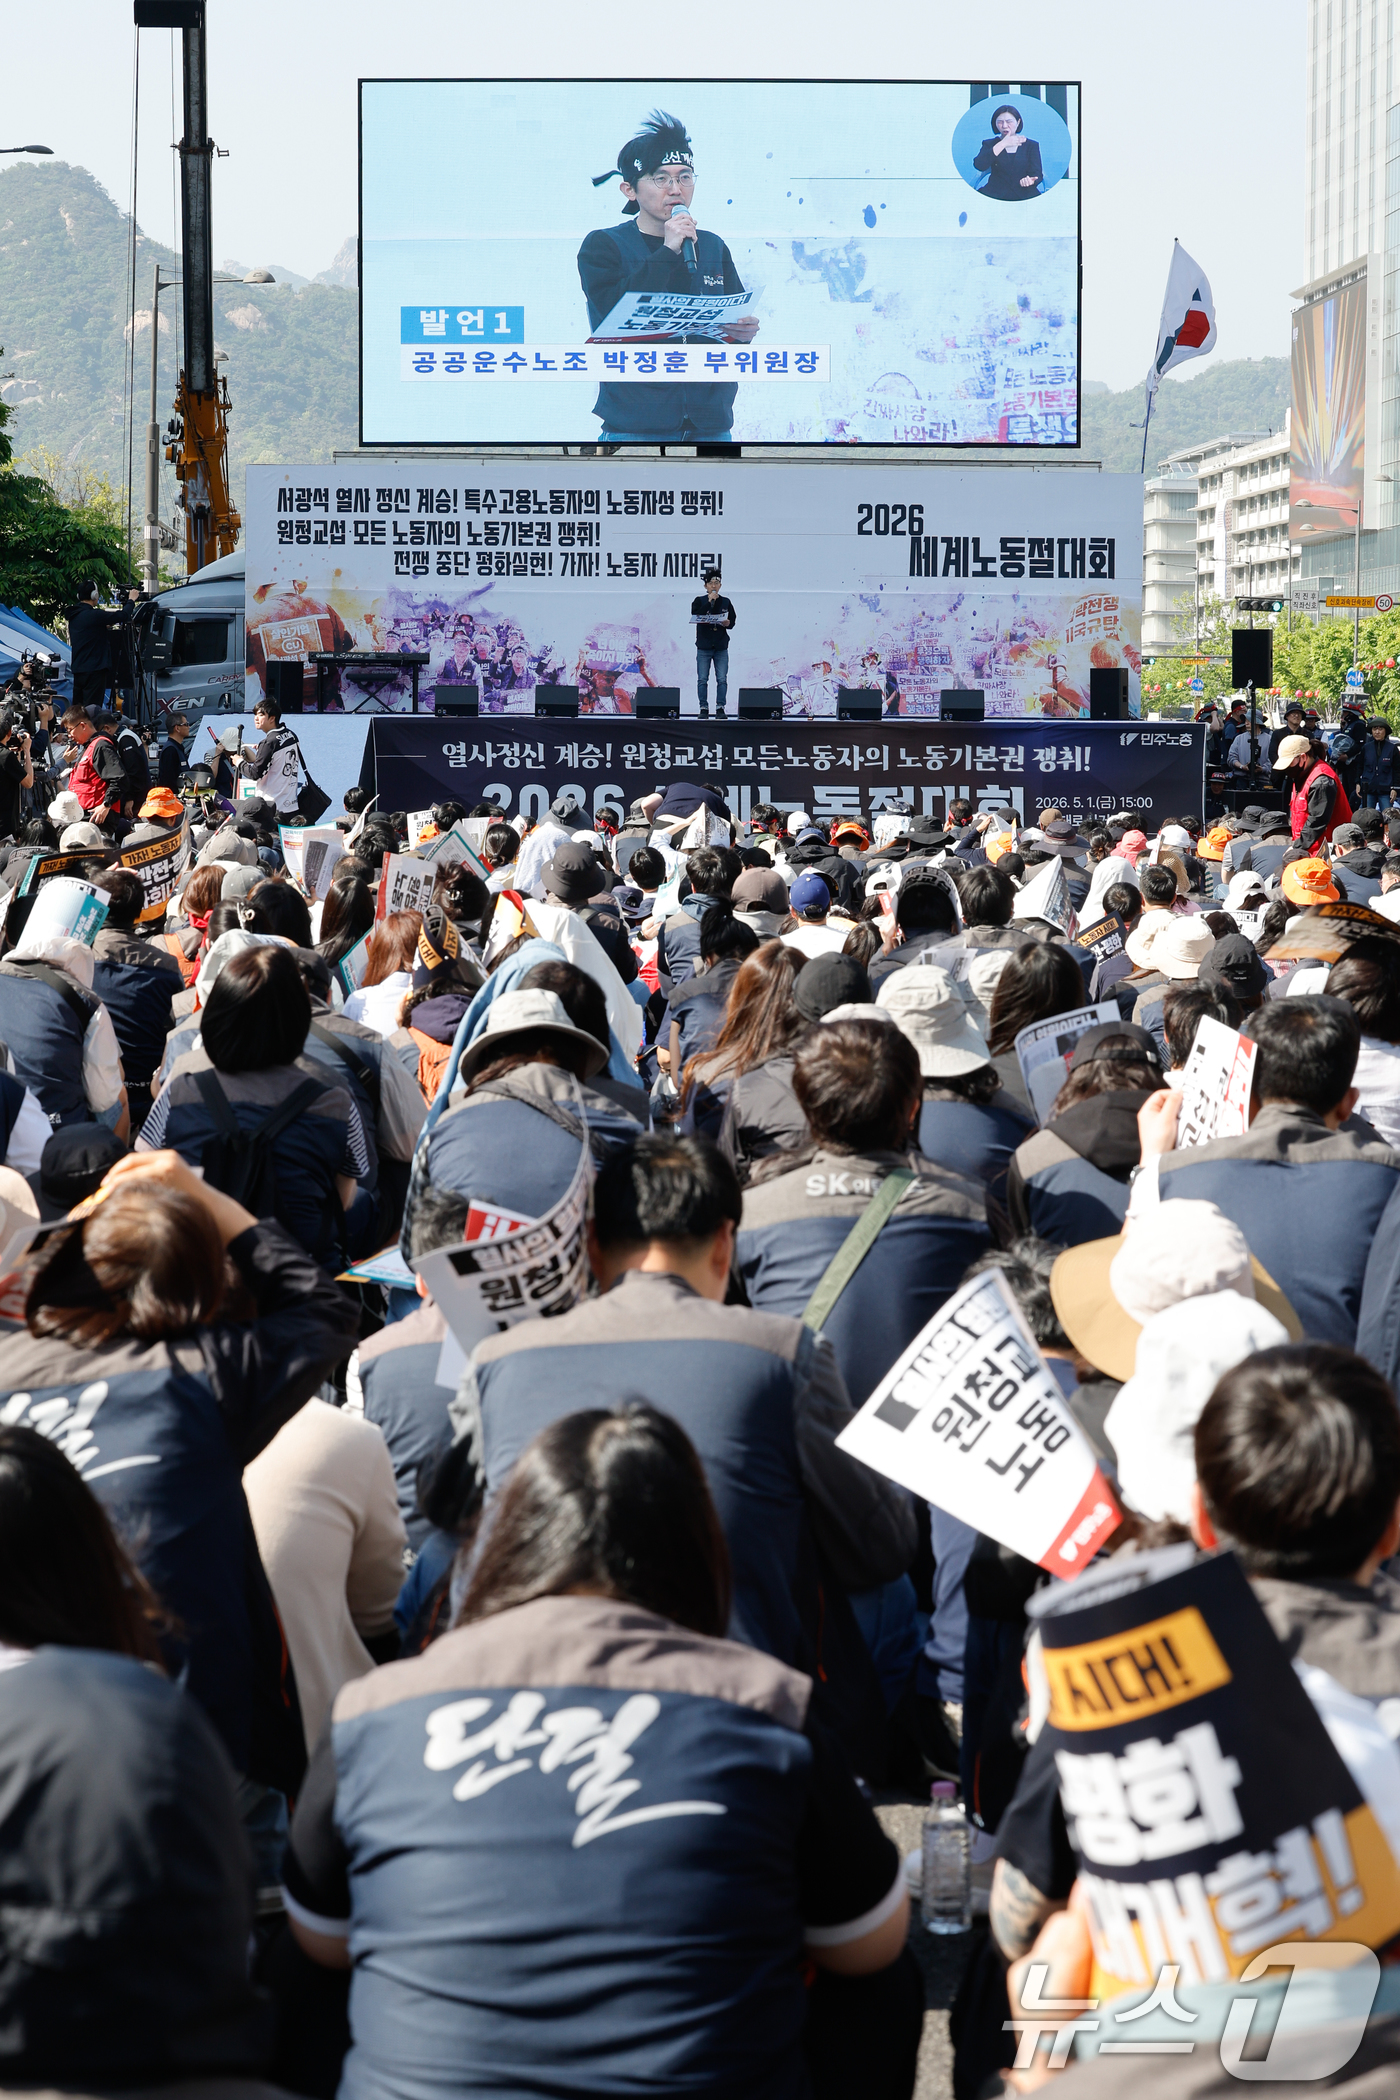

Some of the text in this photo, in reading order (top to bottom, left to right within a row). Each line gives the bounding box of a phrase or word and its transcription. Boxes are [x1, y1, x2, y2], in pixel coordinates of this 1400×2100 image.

[412, 351, 820, 374] 공공운수노조 박정훈 부위원장
[277, 488, 724, 516] 서광석 열사 정신 계승! 특수고용노동자의 노동자성 쟁취!
[857, 503, 924, 536] 2026
[393, 520, 461, 546] 노동자의
[467, 521, 552, 547] 노동기본권
[557, 521, 600, 547] 쟁취!
[394, 551, 429, 576] 전쟁
[436, 551, 470, 576] 중단
[476, 551, 553, 577] 평화실현!
[560, 552, 600, 577] 가자!
[606, 553, 658, 577] 노동자
[909, 536, 1116, 579] 세계노동절대회
[1293, 601, 1317, 609] 직좌신호
[1379, 599, 1390, 607] 50
[286, 641, 299, 650] CU
[1141, 733, 1193, 747] 민주노총
[442, 741, 546, 769] 열사정신
[554, 742, 612, 769] 계승!
[897, 744, 1024, 772] 노동기본권
[1032, 745, 1091, 772] 쟁취!
[1035, 795, 1153, 809] 2026. 5. 1.(금) 15:00
[125, 839, 178, 865] 가자! 노동자
[471, 1225, 557, 1272] 열사의
[1063, 1633, 1194, 1717] 시대!
[423, 1690, 728, 1850] 단결
